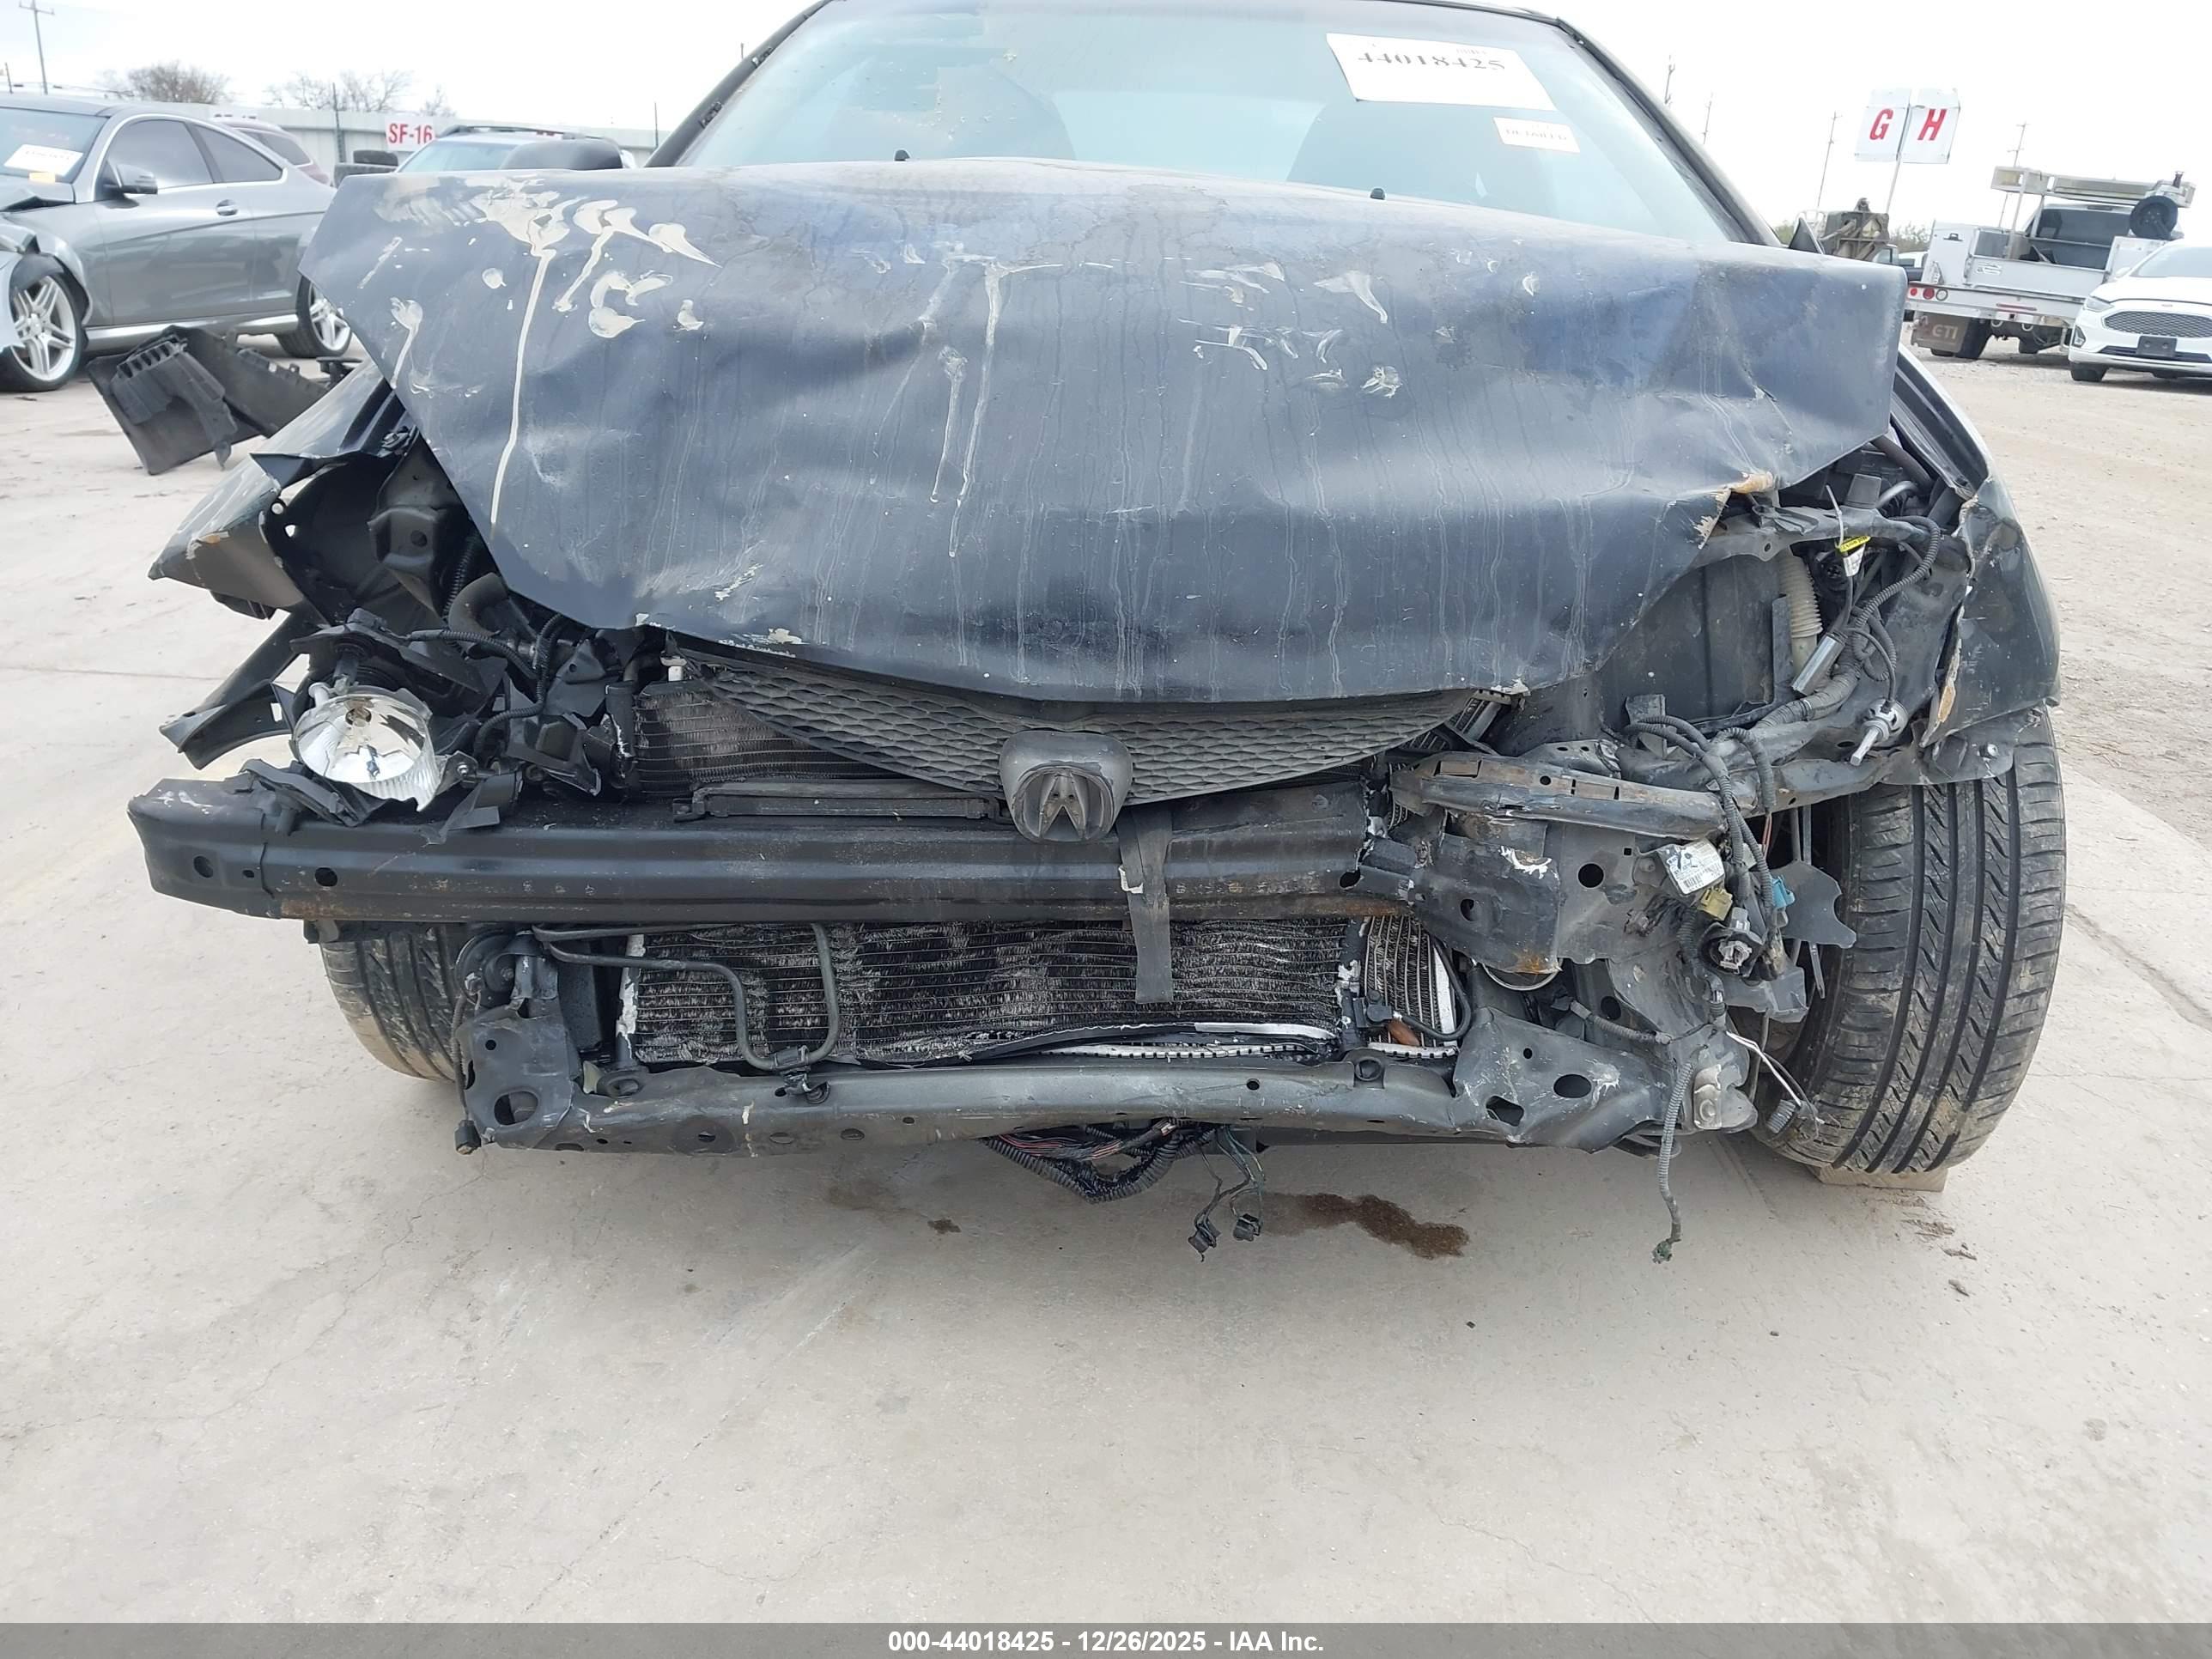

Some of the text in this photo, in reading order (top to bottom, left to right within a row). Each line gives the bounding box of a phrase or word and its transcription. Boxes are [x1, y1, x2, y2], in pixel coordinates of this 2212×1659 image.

[1358, 52, 1505, 70] 44018425
[388, 123, 433, 144] SF-16
[1869, 108, 1893, 140] G
[1917, 108, 1947, 141] H
